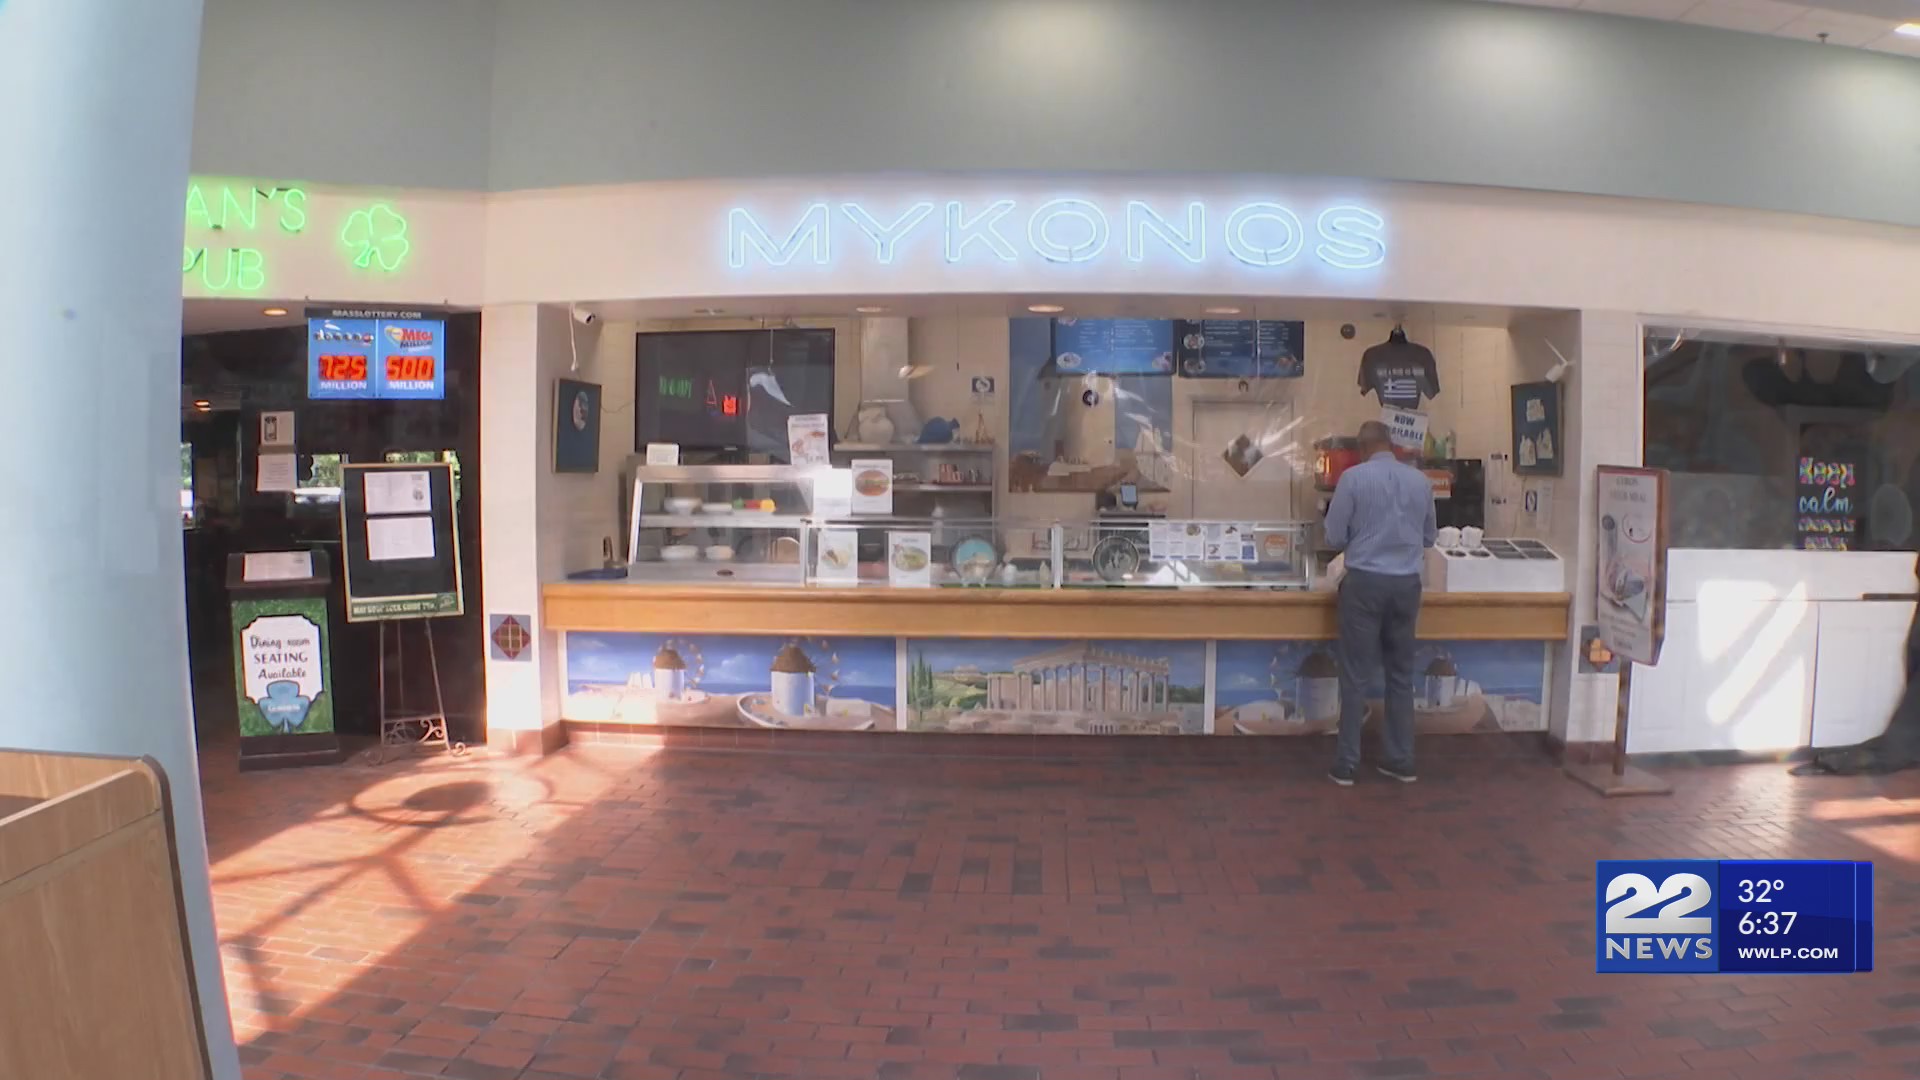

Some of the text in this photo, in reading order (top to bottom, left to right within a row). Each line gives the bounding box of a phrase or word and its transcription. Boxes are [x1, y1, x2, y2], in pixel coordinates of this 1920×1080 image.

[728, 198, 1386, 270] MYKONOS
[331, 309, 422, 319] MASSLOTTERY.COM
[319, 355, 367, 381] 725
[386, 355, 434, 381] 500
[320, 381, 367, 390] MILLION
[389, 381, 434, 390] MILLION
[1394, 413, 1416, 427] NOW
[1799, 486, 1854, 514] calm
[250, 635, 311, 649] Dining room
[254, 651, 308, 664] SEATING
[257, 668, 307, 679] Available
